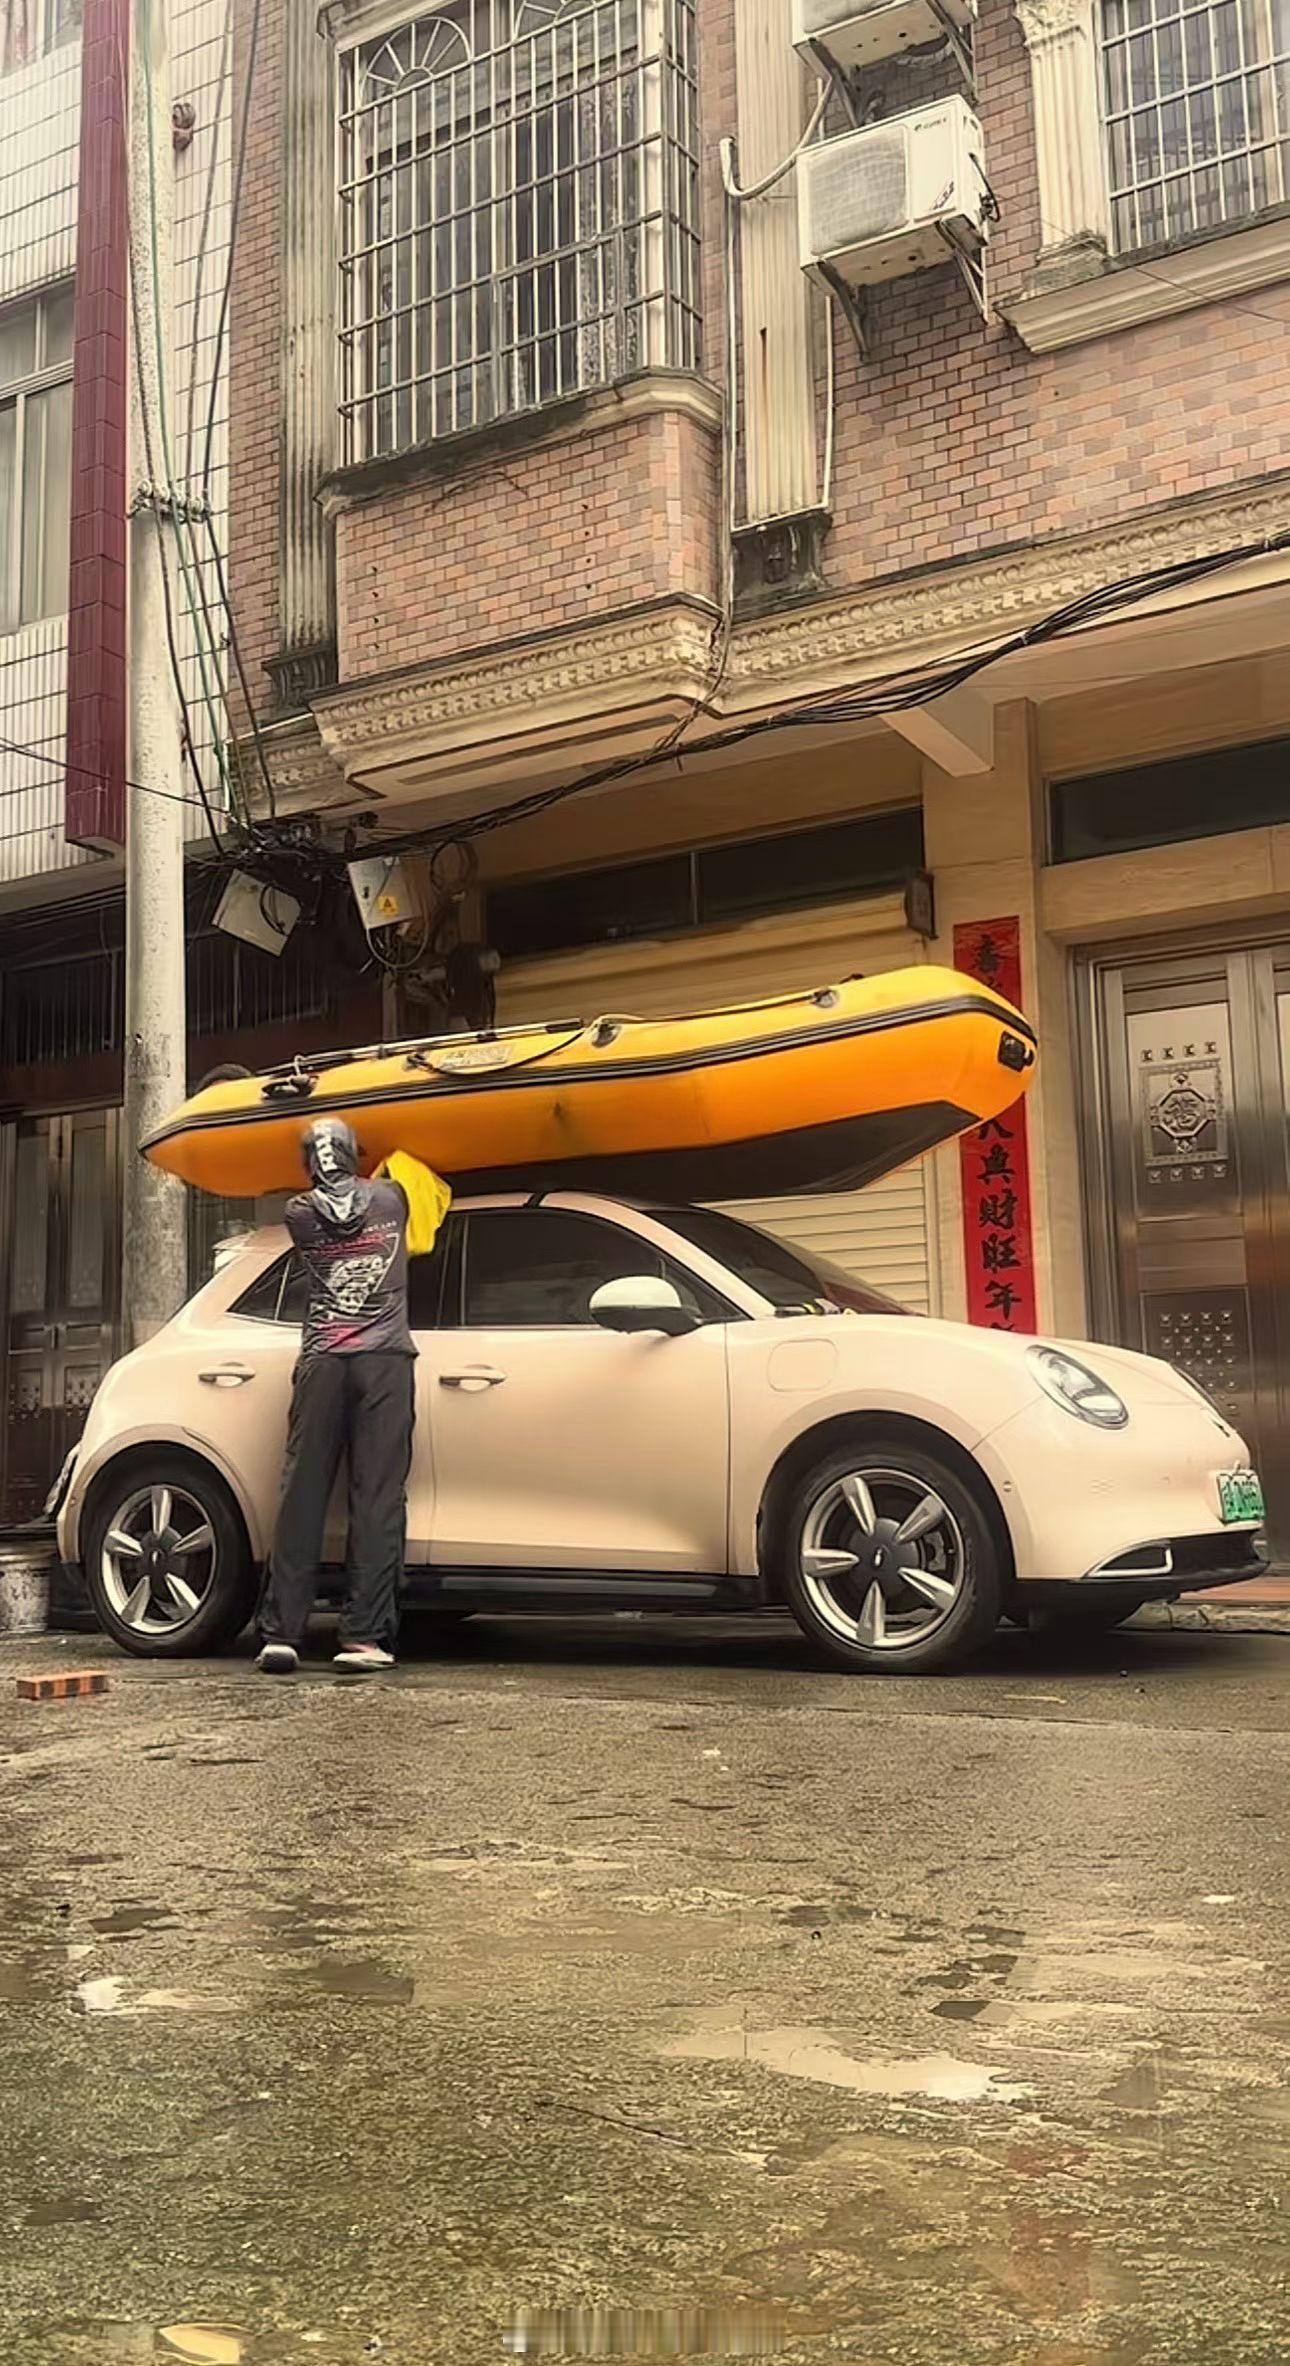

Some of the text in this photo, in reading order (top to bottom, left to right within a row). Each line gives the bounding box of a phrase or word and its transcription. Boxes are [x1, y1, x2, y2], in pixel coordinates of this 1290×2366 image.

[976, 1119, 1022, 1331] 人興財旺年
